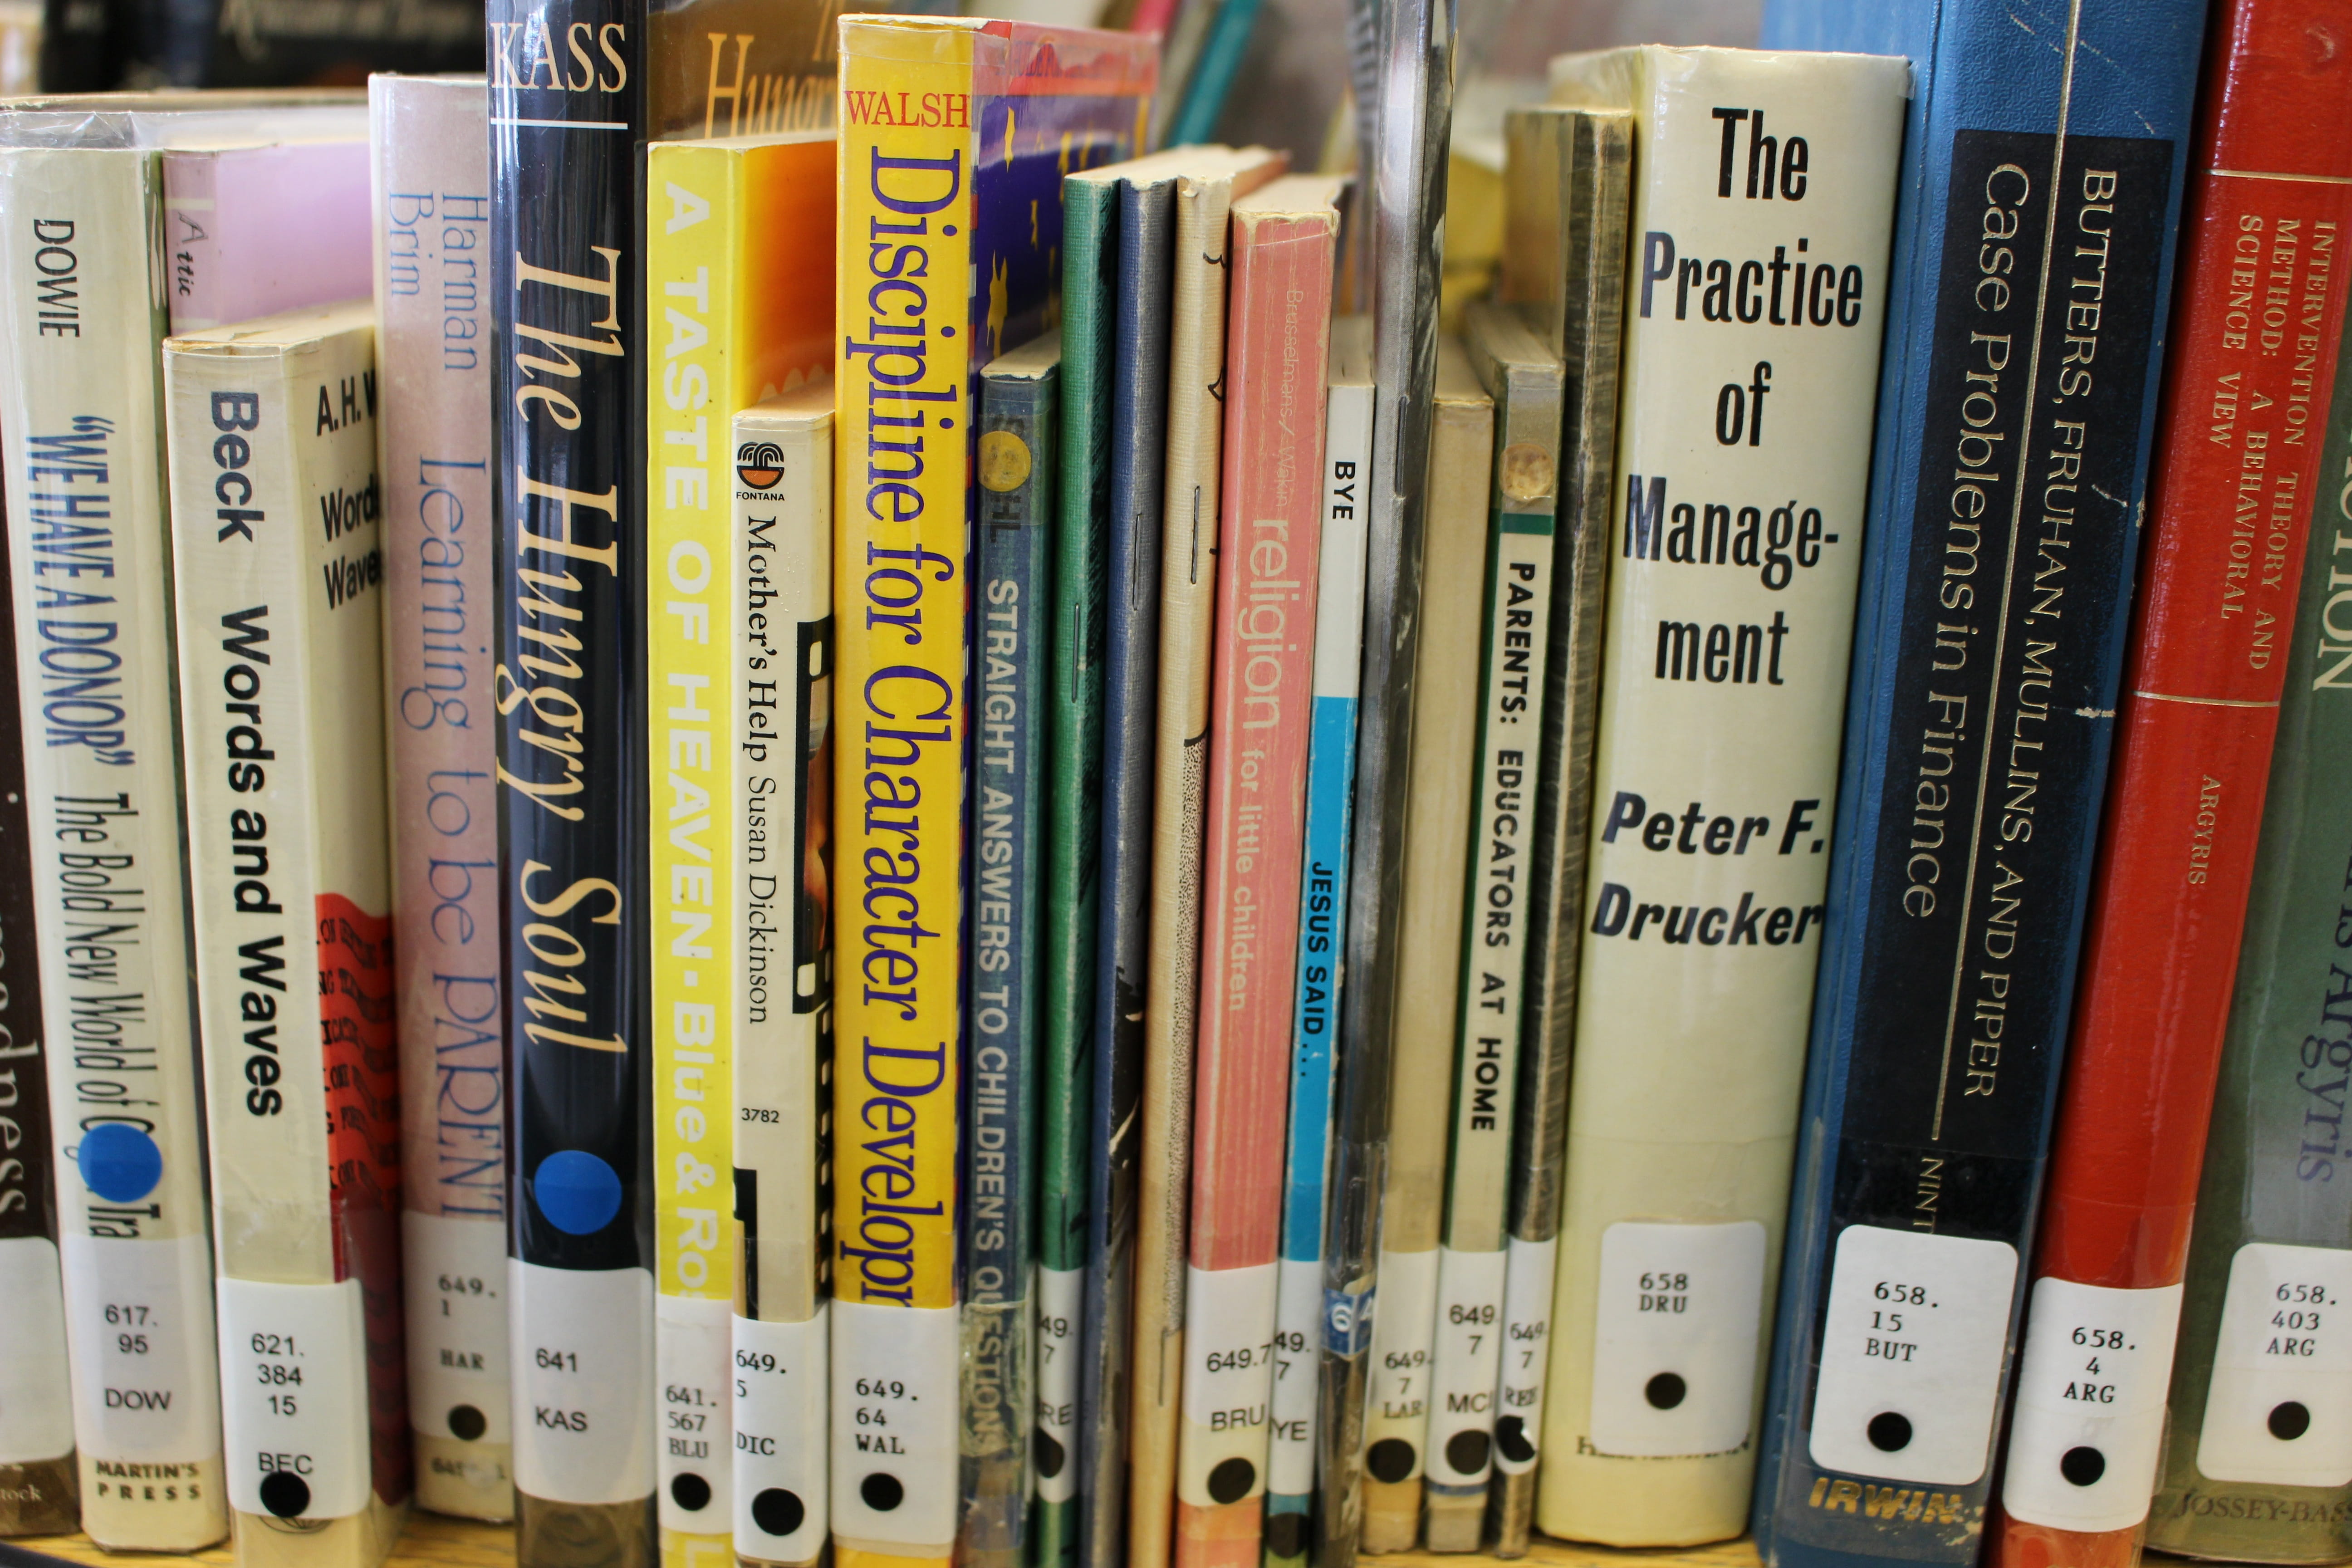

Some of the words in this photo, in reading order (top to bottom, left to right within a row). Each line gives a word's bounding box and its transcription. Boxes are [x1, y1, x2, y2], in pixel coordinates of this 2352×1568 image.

[490, 22, 627, 93] KASS
[846, 91, 970, 128] WALSH
[1712, 107, 1808, 201] The
[665, 181, 710, 236] A
[1974, 163, 2029, 312] Case
[176, 212, 208, 297] Attic
[387, 191, 434, 298] Brim
[34, 218, 80, 338] DOWIE
[442, 192, 489, 372] Harman
[1640, 231, 1862, 328] Practice
[2052, 168, 2117, 404] BUTTERS,
[2223, 214, 2264, 350] SCIENCE
[2259, 217, 2302, 357] METHOD:
[515, 245, 625, 431] The
[845, 146, 961, 522] Discipline
[2283, 220, 2337, 447] INTERVENTION
[664, 266, 710, 510] TASTE
[1716, 361, 1772, 447] of
[2210, 371, 2241, 449] VIEW
[2251, 389, 2273, 411] A
[211, 391, 265, 544] Beck
[736, 491, 785, 502] FONTANA
[1332, 461, 1356, 521] BYE
[1940, 331, 2011, 610] Problems
[29, 493, 115, 578] HAVE
[1623, 474, 1839, 591] Manage-
[2024, 419, 2085, 625] FRUHAN,
[2220, 430, 2269, 620] BEHAVIORAL
[2261, 471, 2298, 591] THEORY
[36, 584, 118, 609] A
[401, 454, 486, 731] Learning
[667, 540, 712, 645] OF
[865, 540, 955, 645] for
[1237, 519, 1301, 730] religion
[495, 465, 617, 822] Hungry
[1499, 562, 1536, 725] PARENTS:
[1655, 611, 1789, 686] ment
[1931, 622, 1979, 672] in
[2249, 608, 2277, 670] AND
[221, 605, 275, 794] Words
[982, 579, 1019, 775] STRAIGHT
[743, 680, 779, 763] Help
[1993, 637, 2057, 851] MULLINS,
[1240, 750, 1265, 790] for
[54, 793, 139, 843] The
[426, 769, 489, 837] to
[668, 673, 713, 960] HEAVEN
[748, 776, 776, 865] Susan
[1602, 791, 1770, 855] Peter
[1779, 799, 1824, 855] F.
[1903, 691, 1968, 918] Finance
[2187, 774, 2221, 886] ARGYRIS
[230, 808, 283, 914] and
[862, 664, 953, 1021] Character
[1235, 805, 1262, 874] little
[1485, 750, 1524, 948] EDUCATORS
[59, 852, 146, 912] Bold
[428, 857, 496, 946] be
[979, 785, 1014, 972] ANSWERS
[1307, 861, 1333, 954] JESUS
[1984, 859, 2024, 959] AND
[1591, 882, 1823, 946] Drucker
[65, 921, 140, 985] New
[520, 858, 628, 1053] Soul
[749, 873, 778, 1025] Dickinson
[1228, 886, 1257, 1011] children
[978, 985, 1009, 1035] TO
[1480, 972, 1505, 1015] AT
[71, 993, 158, 1071] World
[238, 935, 287, 1117] Waves
[1965, 970, 2009, 1098] PIPER
[76, 1080, 160, 1106] of
[673, 1000, 715, 1143] Blue
[1470, 1037, 1502, 1132] HOME
[741, 1107, 780, 1124] 3782
[675, 1150, 716, 1195] &
[975, 1046, 1008, 1252] CHILDREN'S
[676, 1206, 718, 1299] Ro
[1639, 1273, 1689, 1292] 658
[105, 1305, 158, 1327] 617.
[438, 1274, 496, 1298] 649.
[441, 1298, 451, 1317] 1
[1638, 1293, 1688, 1313] DRU
[1873, 1281, 1939, 1309] 658.
[2275, 1283, 2337, 1306] 658.
[118, 1333, 149, 1355] 95
[251, 1333, 305, 1357] 621.
[1469, 1335, 1482, 1355] 7
[1864, 1337, 1918, 1363] BUT
[1870, 1311, 1903, 1333] 15
[2071, 1327, 2136, 1351] 658.
[2266, 1337, 2316, 1357] ARG
[2270, 1310, 2320, 1331] 403
[257, 1363, 303, 1387] 384
[439, 1348, 485, 1371] HAR
[535, 1348, 578, 1372] 641
[735, 1350, 788, 1375] 649.
[1043, 1343, 1055, 1364] 7
[1206, 1343, 1272, 1372] 649.7
[1276, 1360, 1291, 1380] 7
[1521, 1350, 1534, 1369] 7
[2085, 1356, 2100, 1376] 4
[104, 1388, 171, 1411] DOW
[269, 1395, 297, 1416] 15
[666, 1384, 718, 1407] 641.
[735, 1379, 748, 1398] 5
[855, 1377, 919, 1402] 649.
[855, 1407, 888, 1427] 64
[1211, 1404, 1265, 1432] BRU
[1399, 1377, 1411, 1395] 7
[2062, 1381, 2116, 1404] ARG
[534, 1406, 588, 1432] KAS
[668, 1411, 706, 1432] 567
[668, 1436, 709, 1460] BLU
[735, 1430, 776, 1456] DIC
[855, 1433, 906, 1455] WAL
[259, 1452, 313, 1475] BEC
[1808, 1477, 1963, 1525] IRWIN
